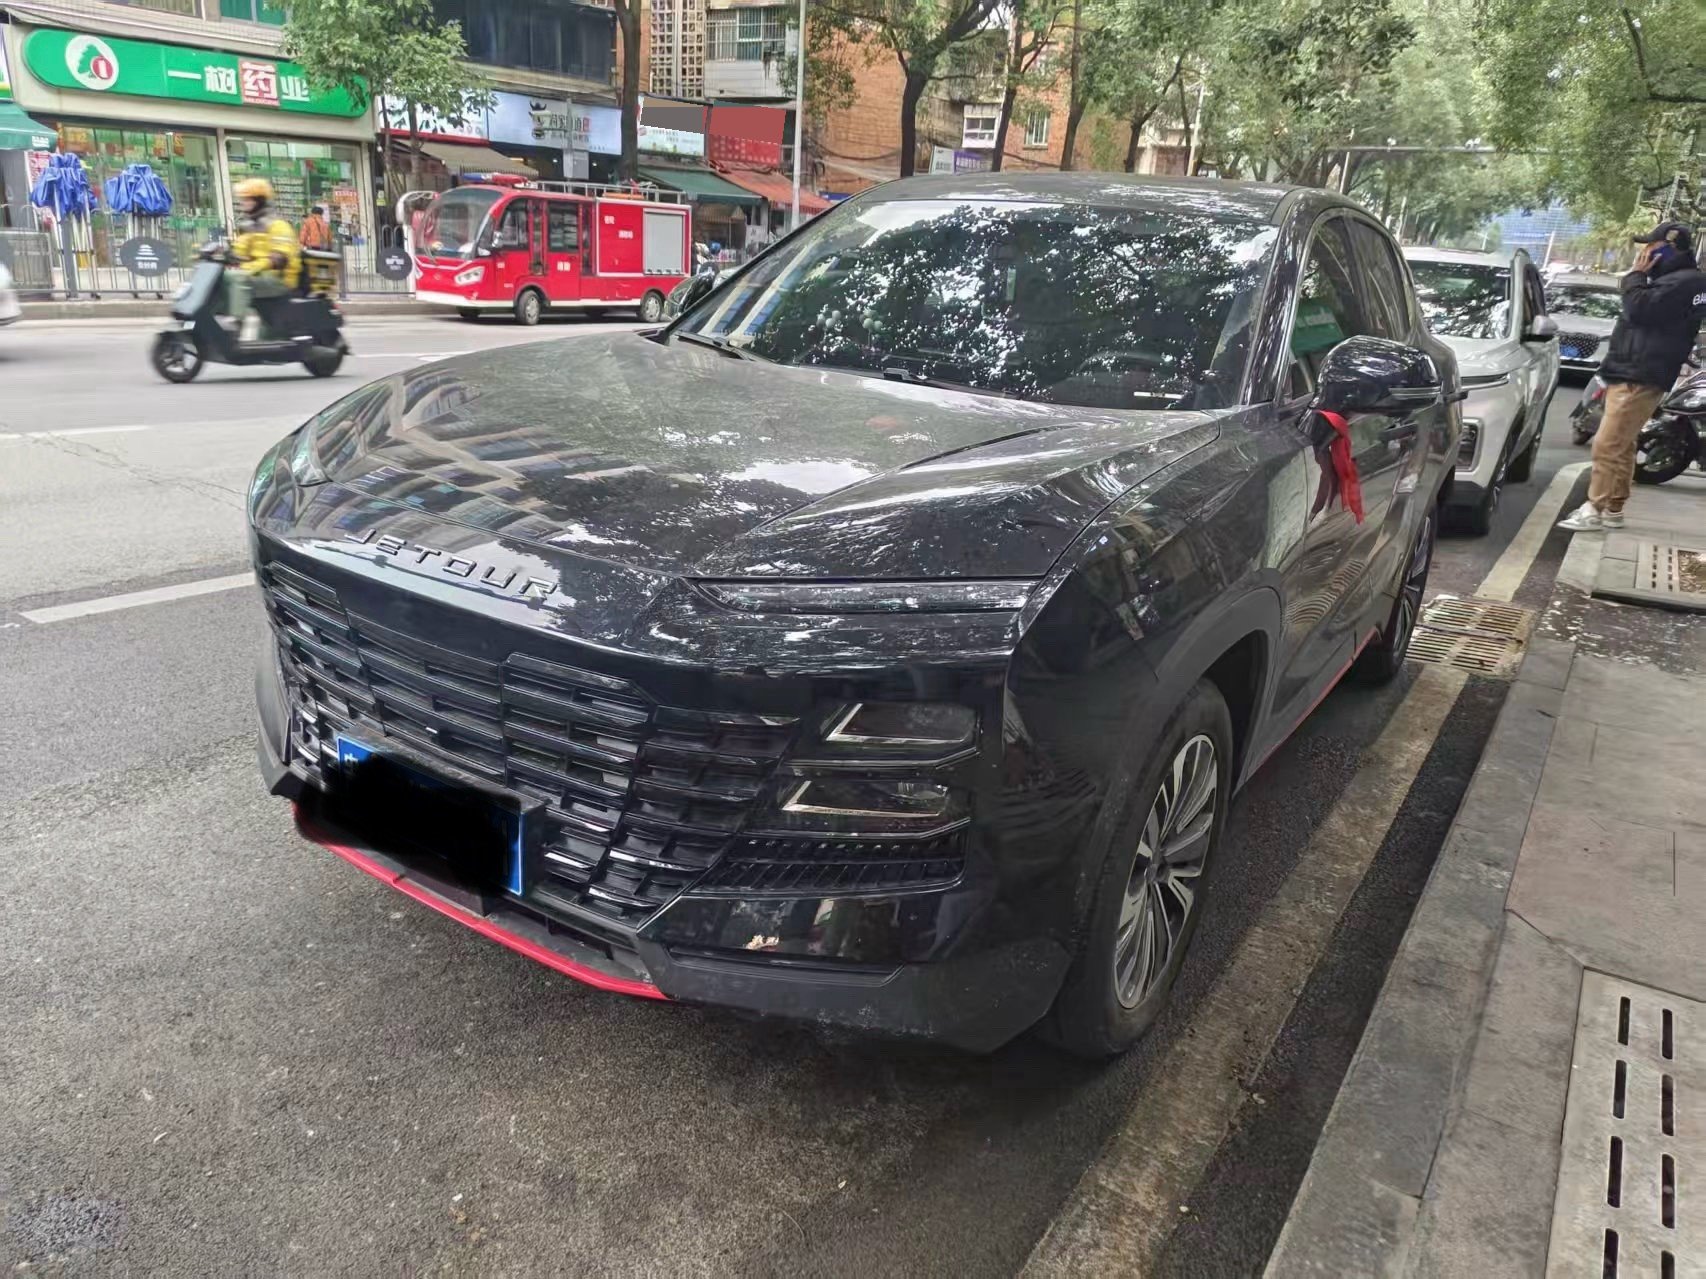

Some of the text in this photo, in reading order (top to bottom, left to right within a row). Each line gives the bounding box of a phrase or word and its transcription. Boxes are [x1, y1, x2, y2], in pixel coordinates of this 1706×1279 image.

[167, 61, 310, 102] 一树药业
[344, 528, 557, 601] JETOUR
